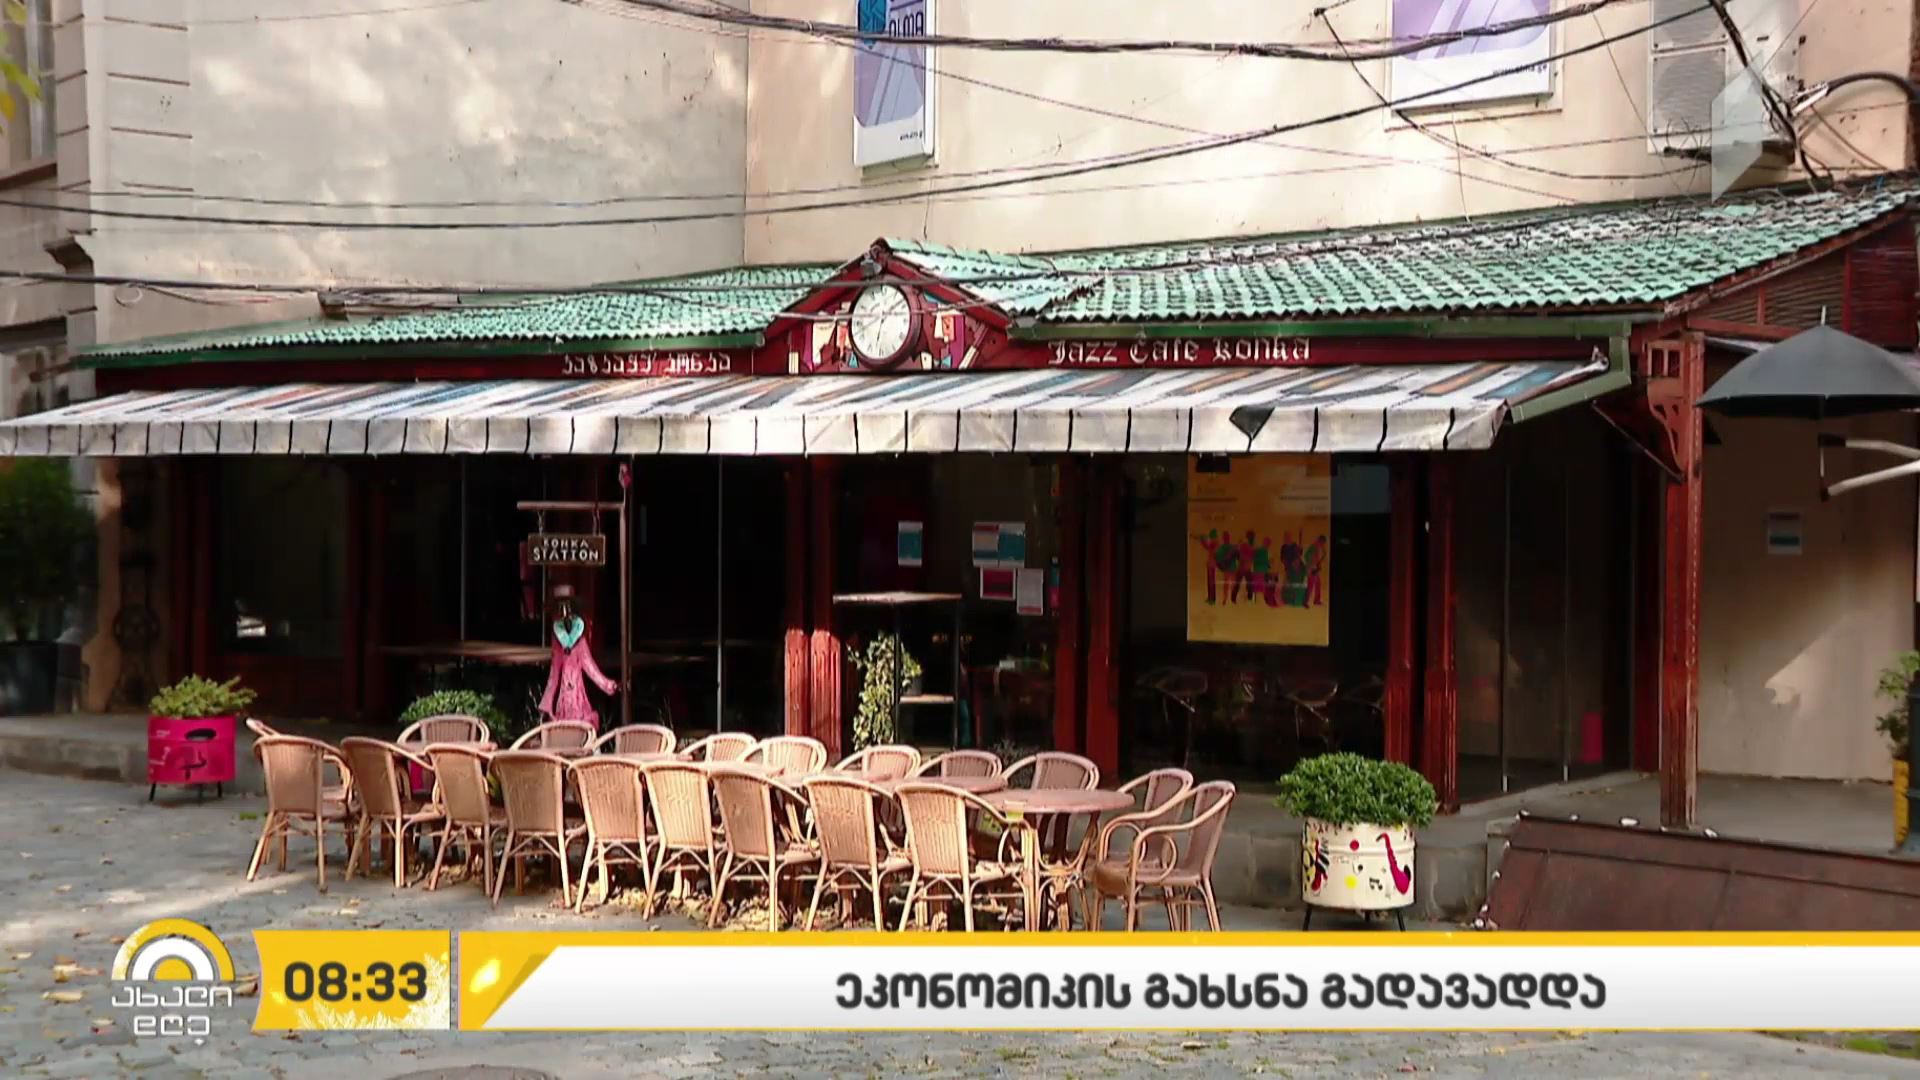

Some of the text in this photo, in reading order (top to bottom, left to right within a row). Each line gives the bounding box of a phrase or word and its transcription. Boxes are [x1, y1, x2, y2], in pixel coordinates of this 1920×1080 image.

[1048, 339, 1118, 365] Jazz
[1129, 338, 1199, 364] Cafe
[533, 547, 598, 561] STATION
